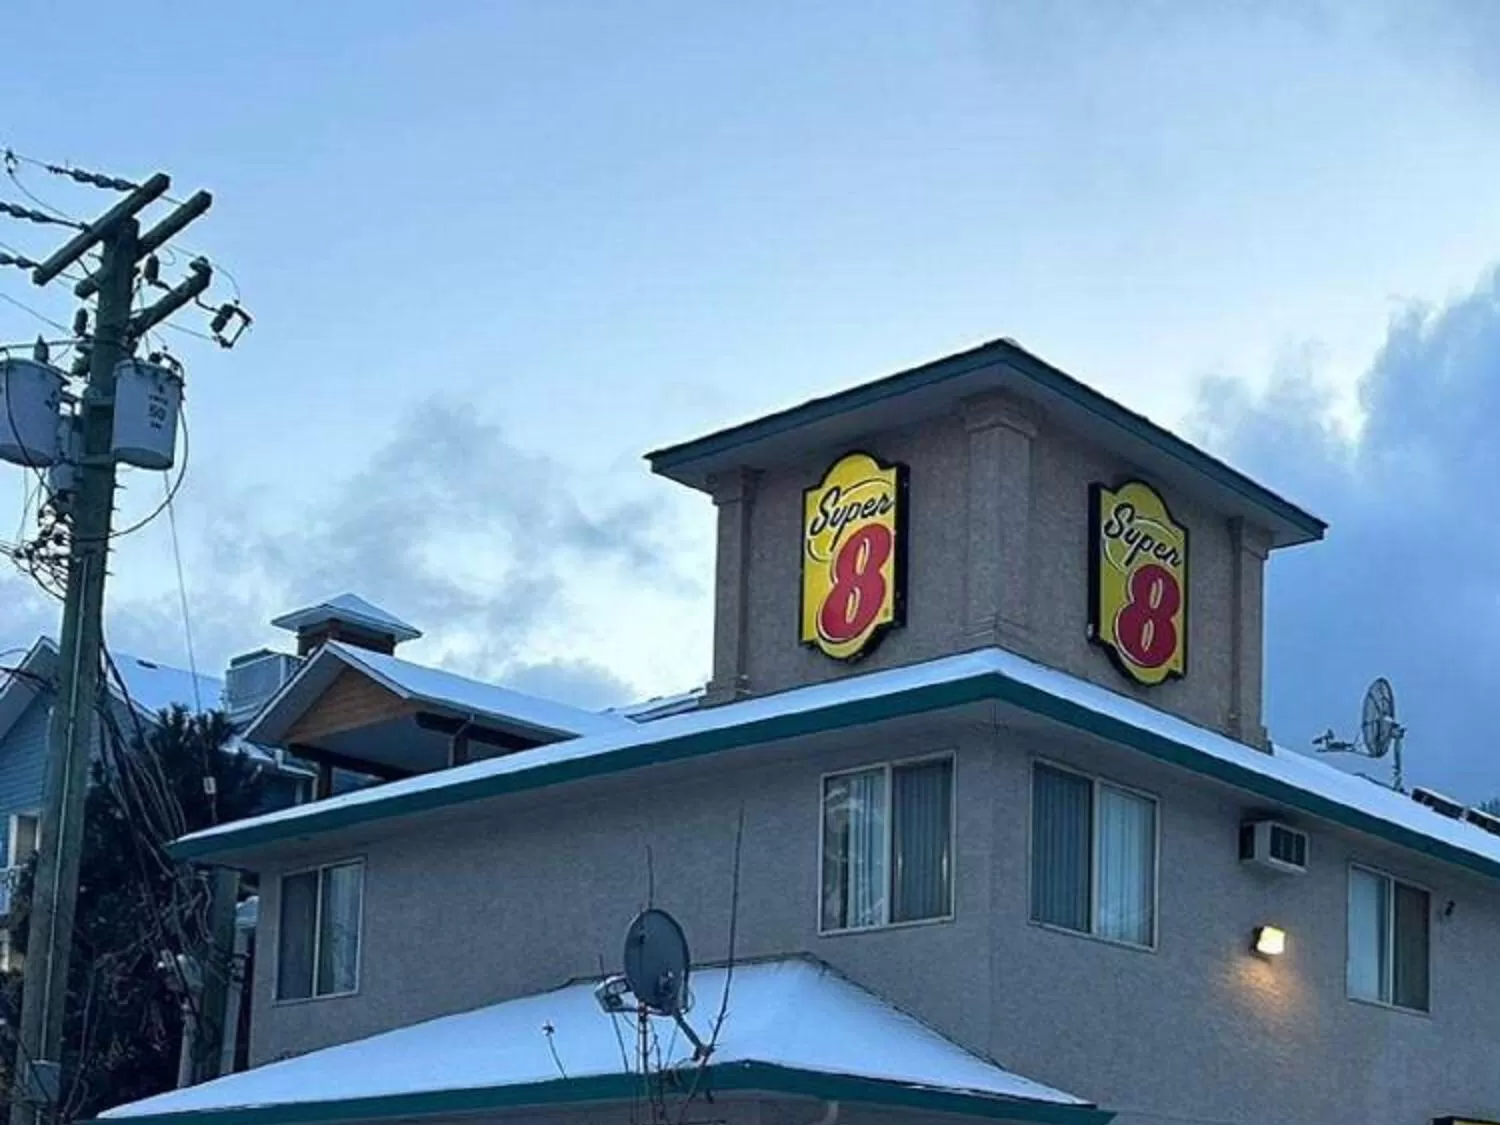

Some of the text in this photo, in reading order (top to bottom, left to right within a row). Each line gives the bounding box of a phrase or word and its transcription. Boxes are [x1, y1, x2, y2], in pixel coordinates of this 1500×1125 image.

[810, 485, 895, 552] Super
[1104, 502, 1181, 567] Super
[816, 522, 893, 643] 8
[1113, 563, 1182, 669] 8
